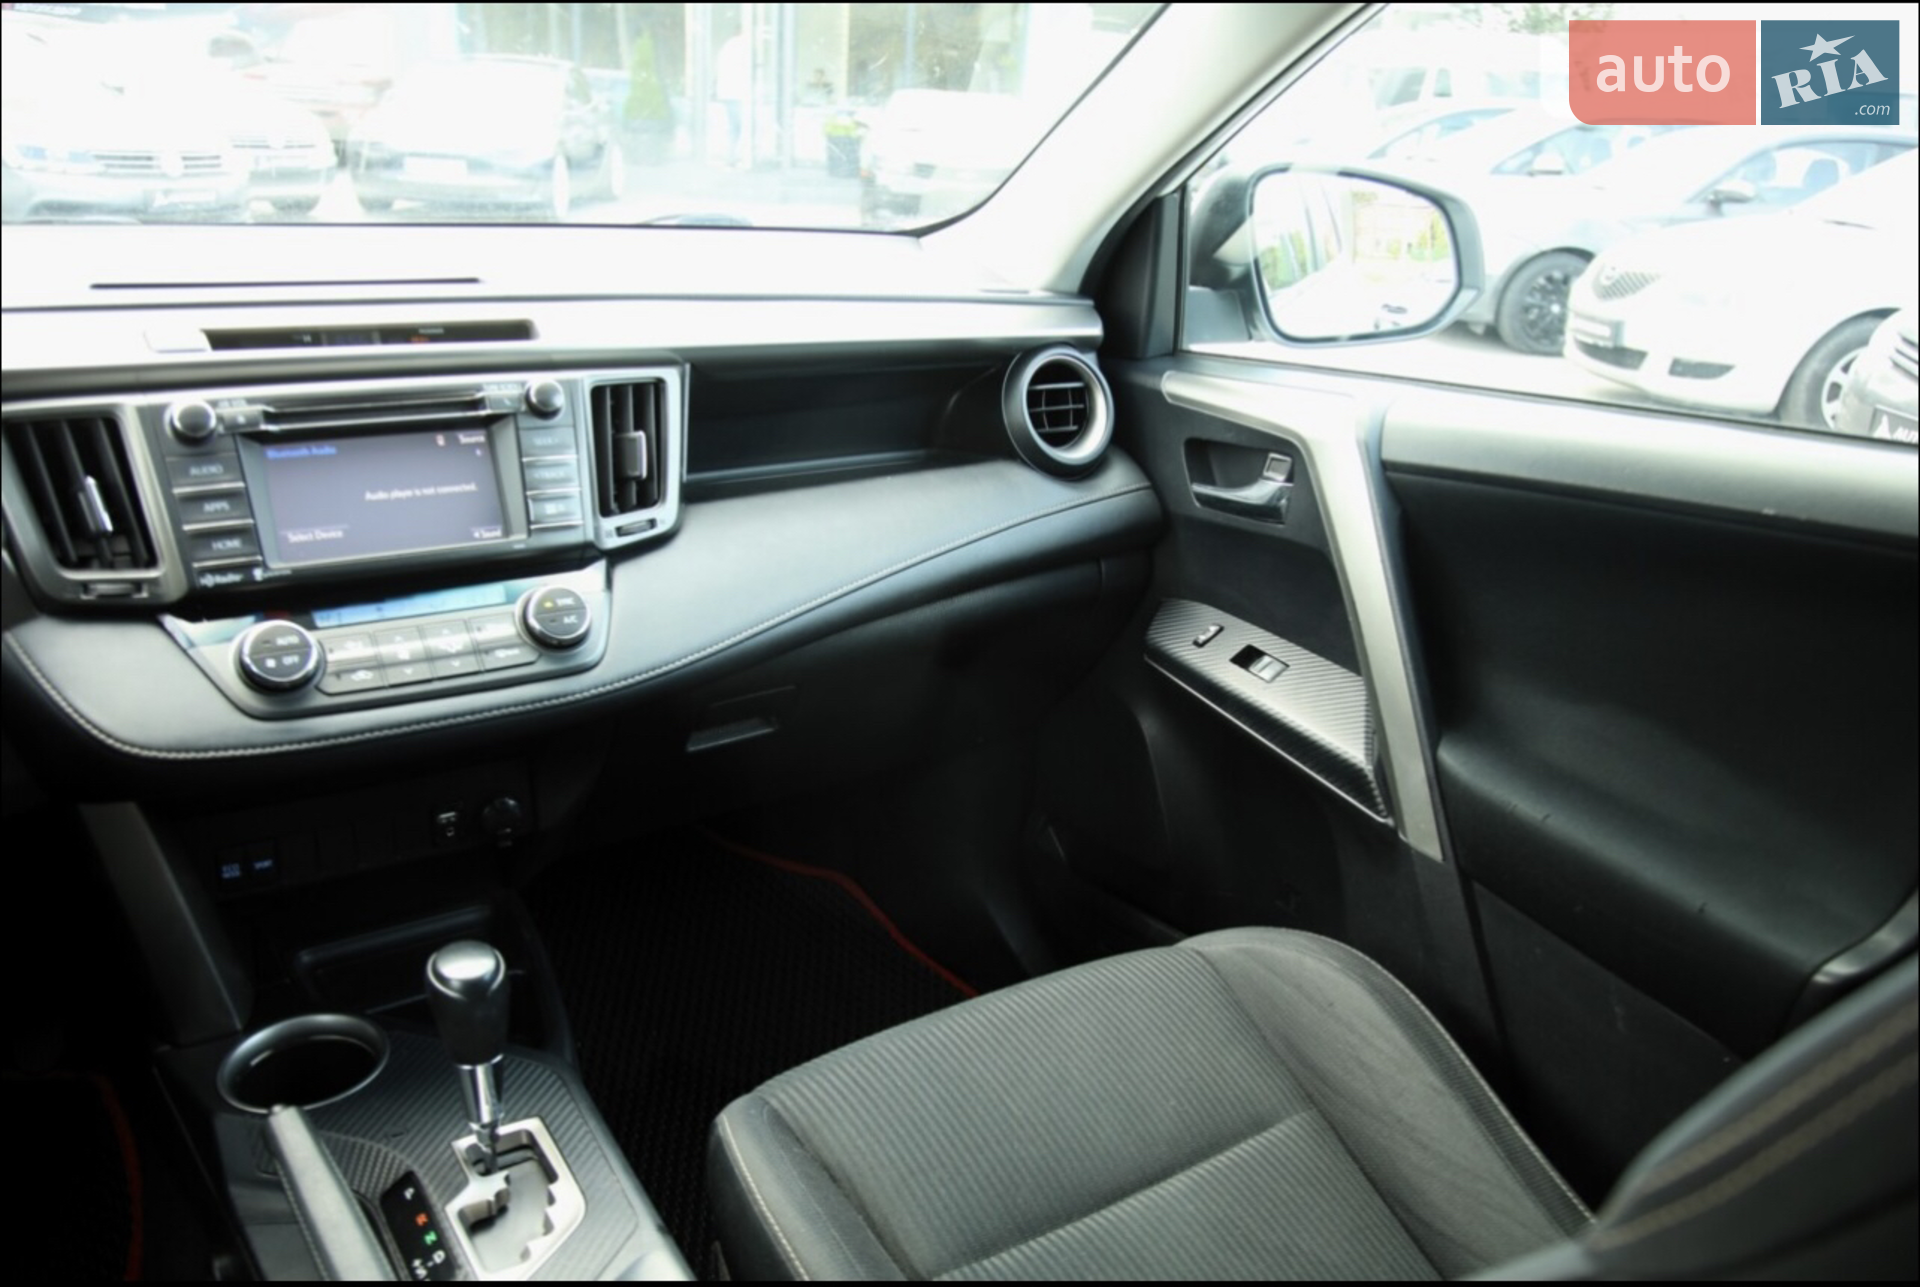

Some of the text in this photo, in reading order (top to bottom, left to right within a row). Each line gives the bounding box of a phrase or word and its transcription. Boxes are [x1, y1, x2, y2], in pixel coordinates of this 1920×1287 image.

[458, 434, 486, 445] Source
[265, 445, 338, 459] Bluetooth Audio
[189, 464, 224, 476] AUDIO
[364, 490, 389, 501] Audio
[390, 488, 413, 501] player
[413, 488, 421, 497] is
[421, 486, 436, 496] not
[203, 501, 230, 513] APPS
[286, 529, 344, 544] Select Device
[211, 538, 243, 551] HOME
[403, 1187, 415, 1200] P
[415, 1213, 428, 1227] R
[424, 1230, 438, 1246] N
[432, 1249, 446, 1264] D
